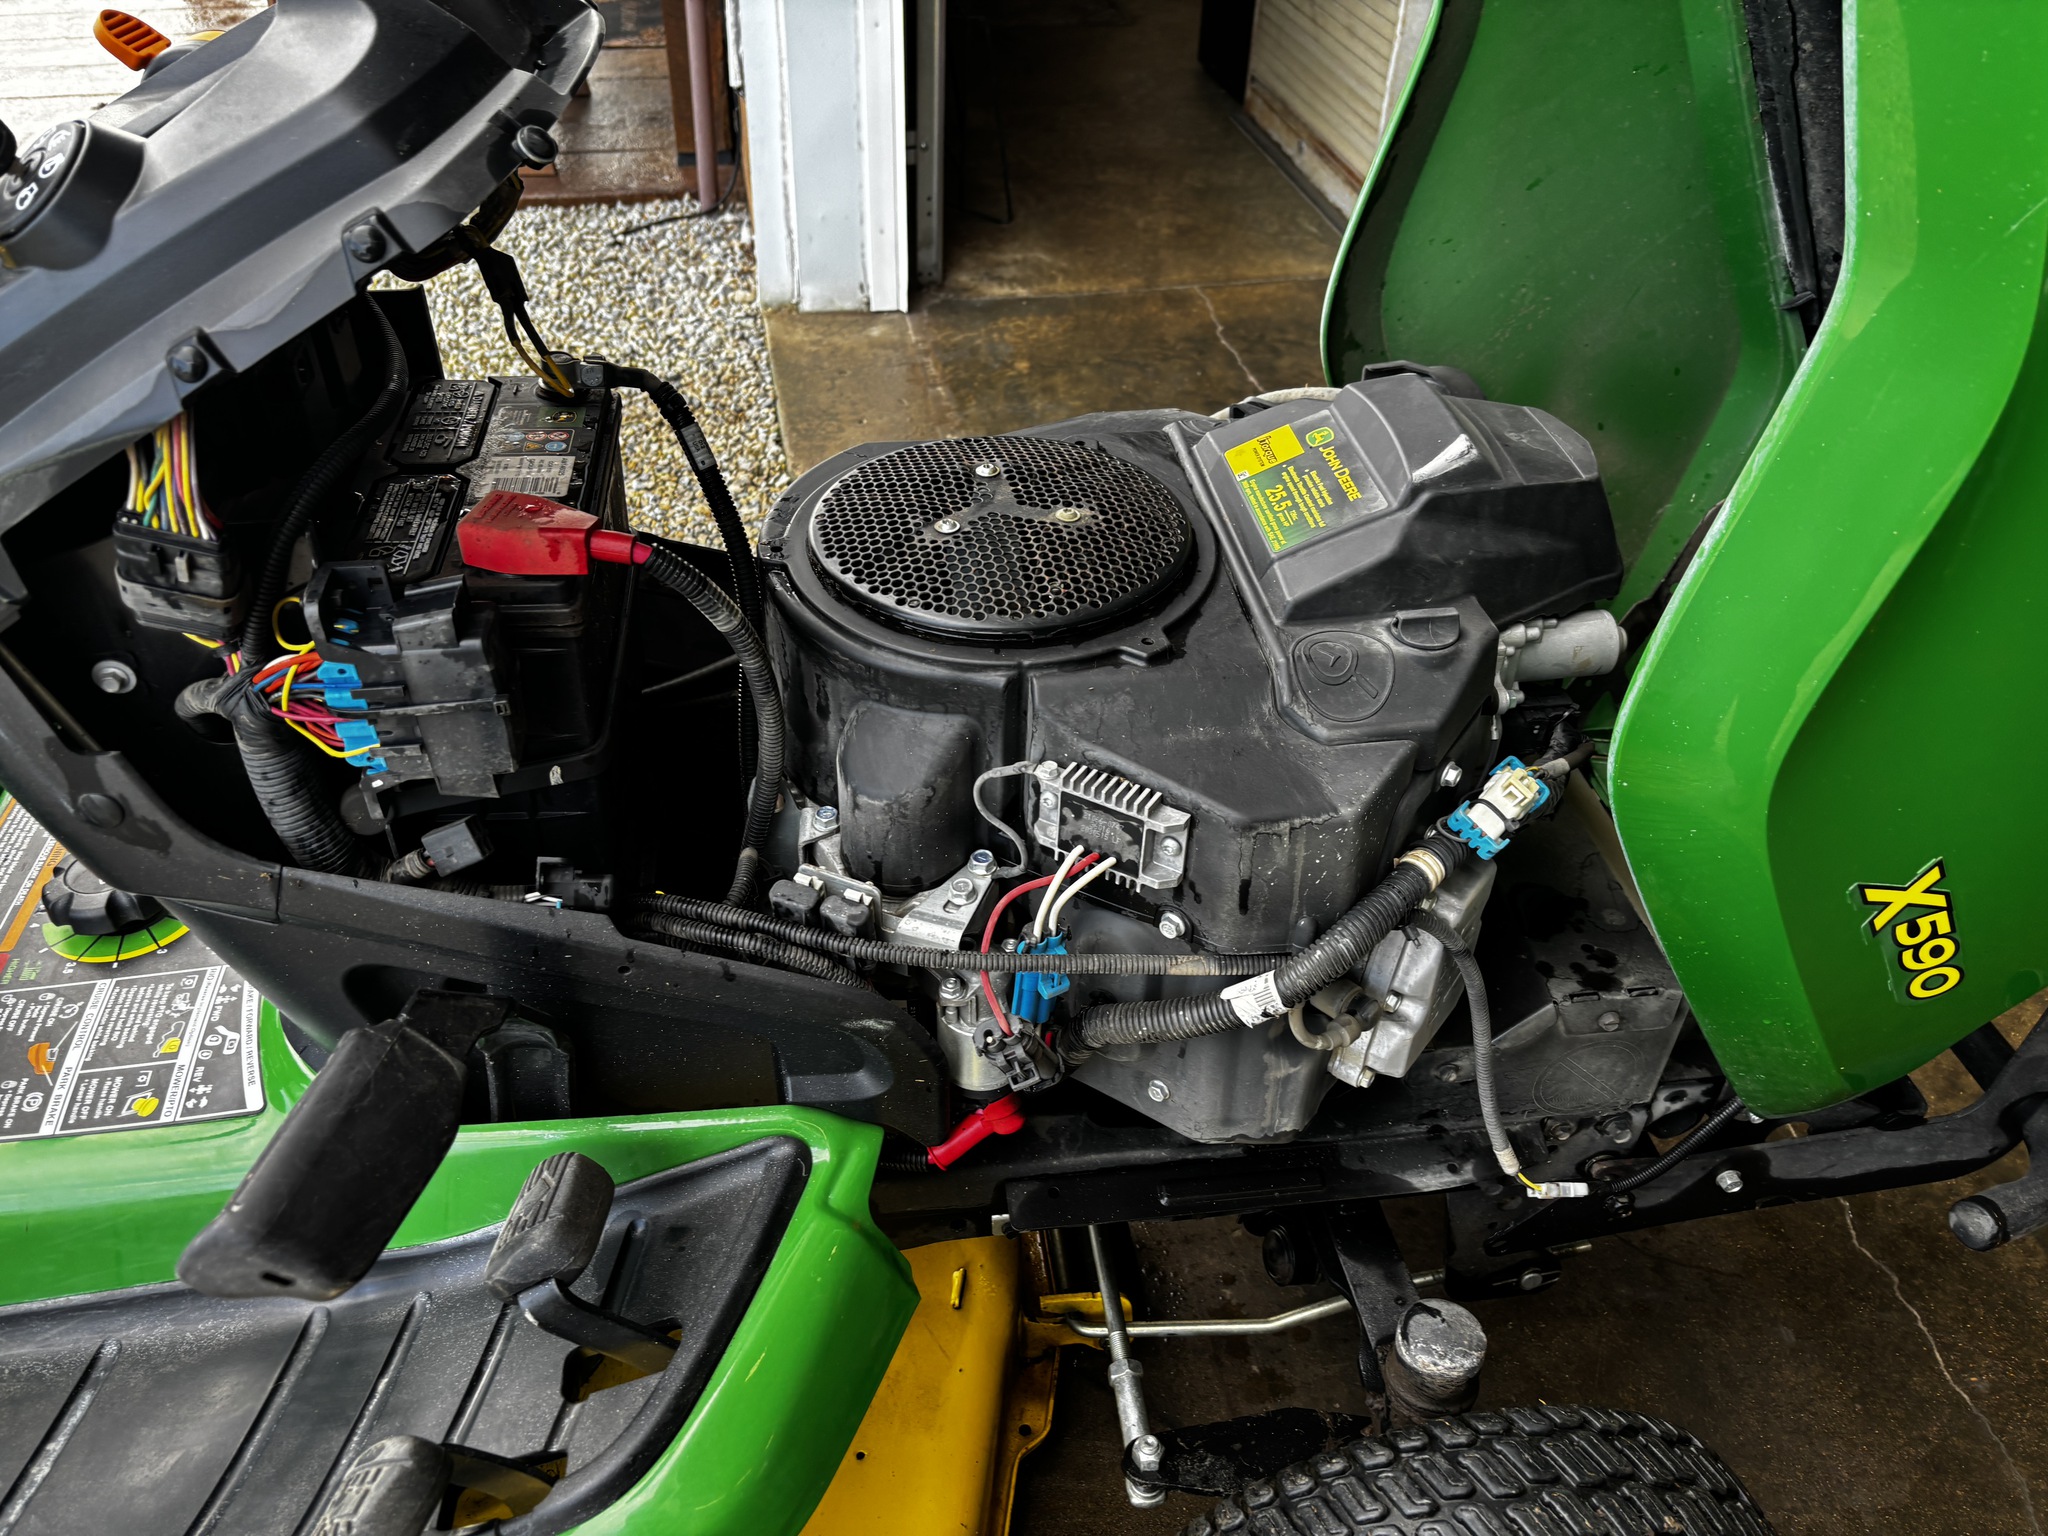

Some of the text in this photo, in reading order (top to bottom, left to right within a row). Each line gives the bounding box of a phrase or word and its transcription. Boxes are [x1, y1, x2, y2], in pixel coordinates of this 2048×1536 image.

[1319, 446, 1362, 502] JOHN DEERE
[1266, 485, 1291, 511] 25.5
[1858, 856, 1964, 1000] X590
[63, 962, 76, 974] 3.5
[7, 1000, 26, 1031] CRUISE OFF
[45, 997, 64, 1026] CRUISE ON
[73, 983, 106, 1049] CRUISE CONTROL
[155, 1005, 166, 1017] PTO
[211, 1006, 222, 1021] FWD
[111, 1031, 120, 1041] RIO
[145, 1019, 159, 1044] engaged
[193, 1067, 204, 1082] REV
[4, 1078, 29, 1128] PARK BRAKE ON
[46, 1067, 72, 1125] PARK BRAKE
[68, 1083, 87, 1123] Lower handle
[80, 1079, 99, 1119] MOWER OFF
[104, 1077, 123, 1116] MOWER ON
[164, 1065, 185, 1117] MOWER/PTO
[94, 1099, 105, 1118] handle
